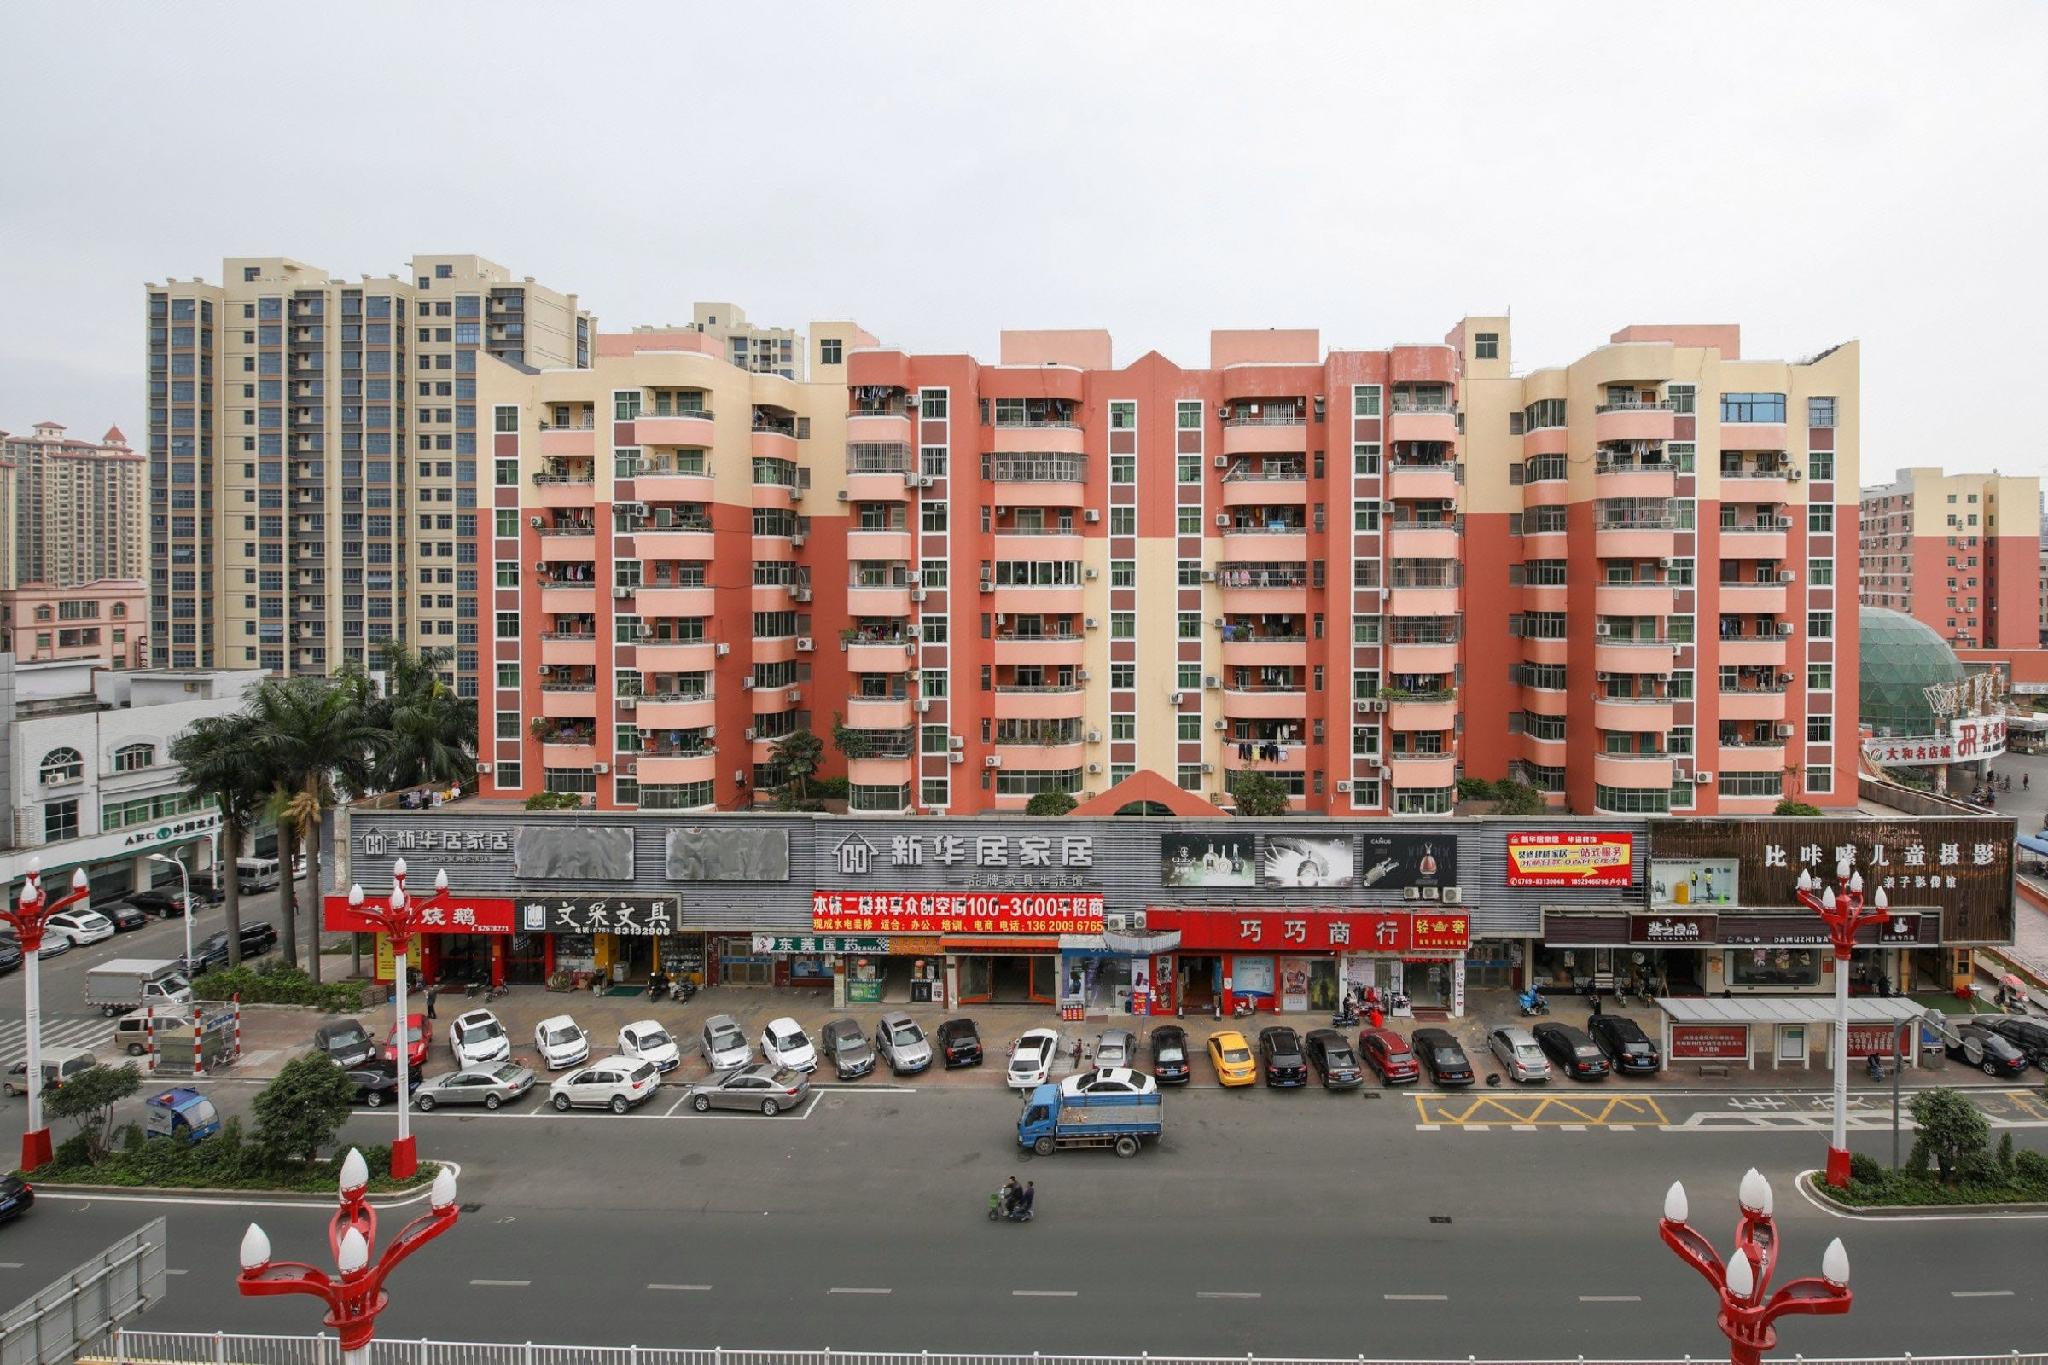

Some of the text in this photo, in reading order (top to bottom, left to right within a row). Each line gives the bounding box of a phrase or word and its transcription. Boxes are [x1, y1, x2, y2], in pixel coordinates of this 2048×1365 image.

[125, 832, 154, 845] ABC
[397, 830, 509, 850] 新华居家居
[891, 834, 1094, 867] 新华居家居
[966, 873, 1084, 887] 品牌家具生活馆
[1049, 920, 1074, 931] 2009
[1077, 920, 1103, 931] 6765
[1240, 919, 1399, 945] 巧巧商行
[778, 937, 859, 951] 东莞国药
